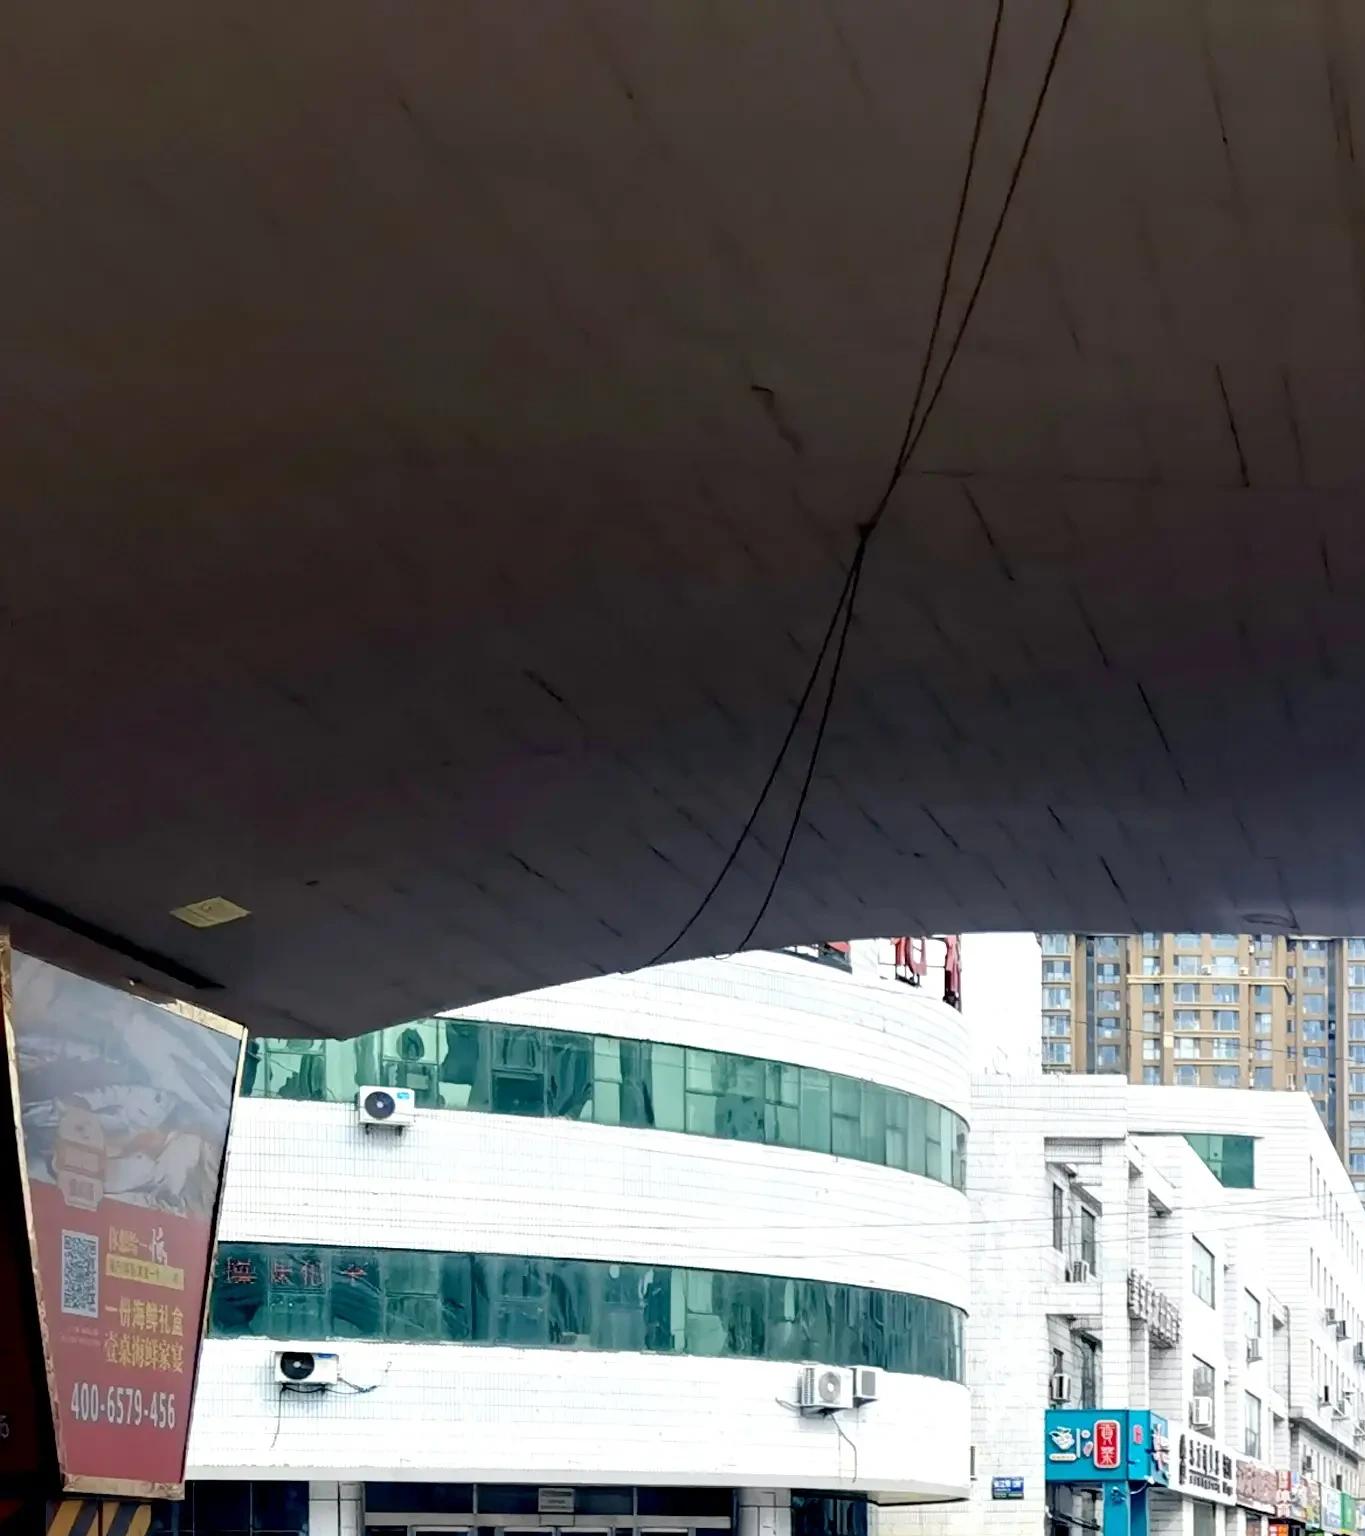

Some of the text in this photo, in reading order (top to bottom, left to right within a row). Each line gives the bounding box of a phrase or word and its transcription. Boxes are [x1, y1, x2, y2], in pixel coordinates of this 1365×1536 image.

[105, 1296, 184, 1337] 一份海鲜礼盒
[71, 1382, 176, 1430] 400-6579-456
